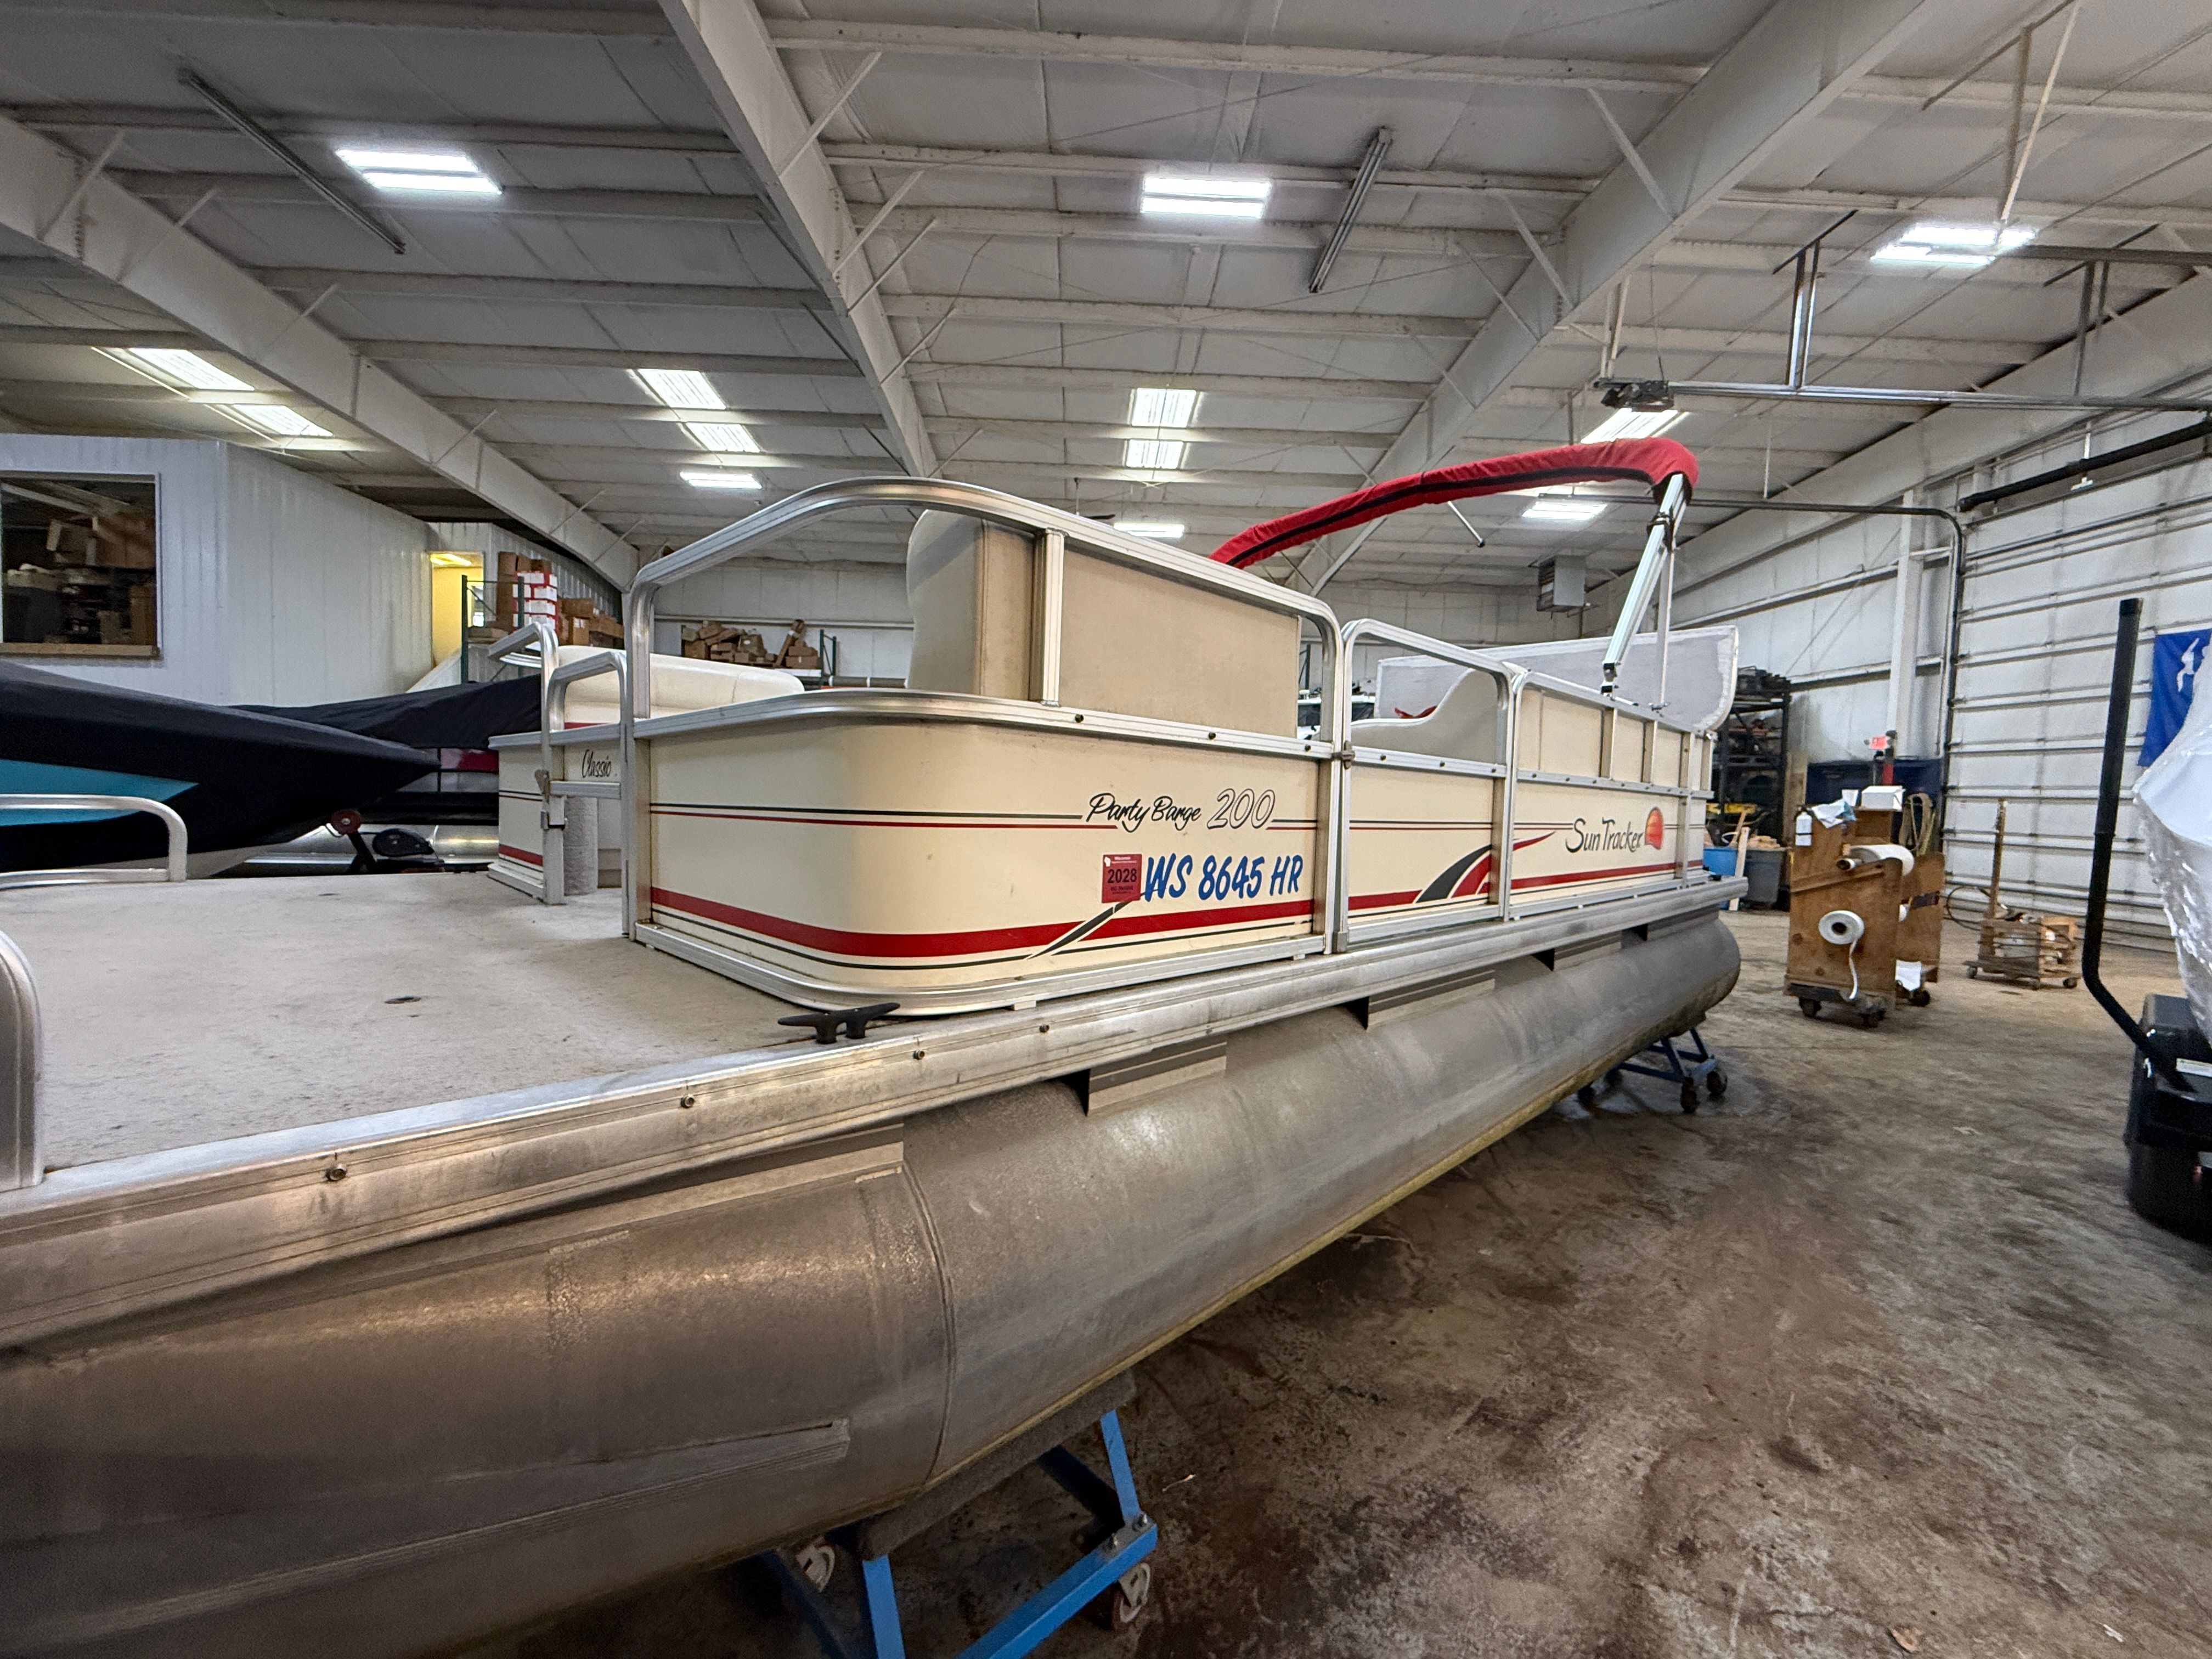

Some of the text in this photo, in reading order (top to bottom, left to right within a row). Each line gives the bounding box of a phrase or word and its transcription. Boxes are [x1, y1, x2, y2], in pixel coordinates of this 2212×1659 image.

[1086, 788, 1276, 833] Party Barge 200
[1107, 868, 1137, 883] 2028
[1144, 853, 1303, 902] WS 8645 HR
